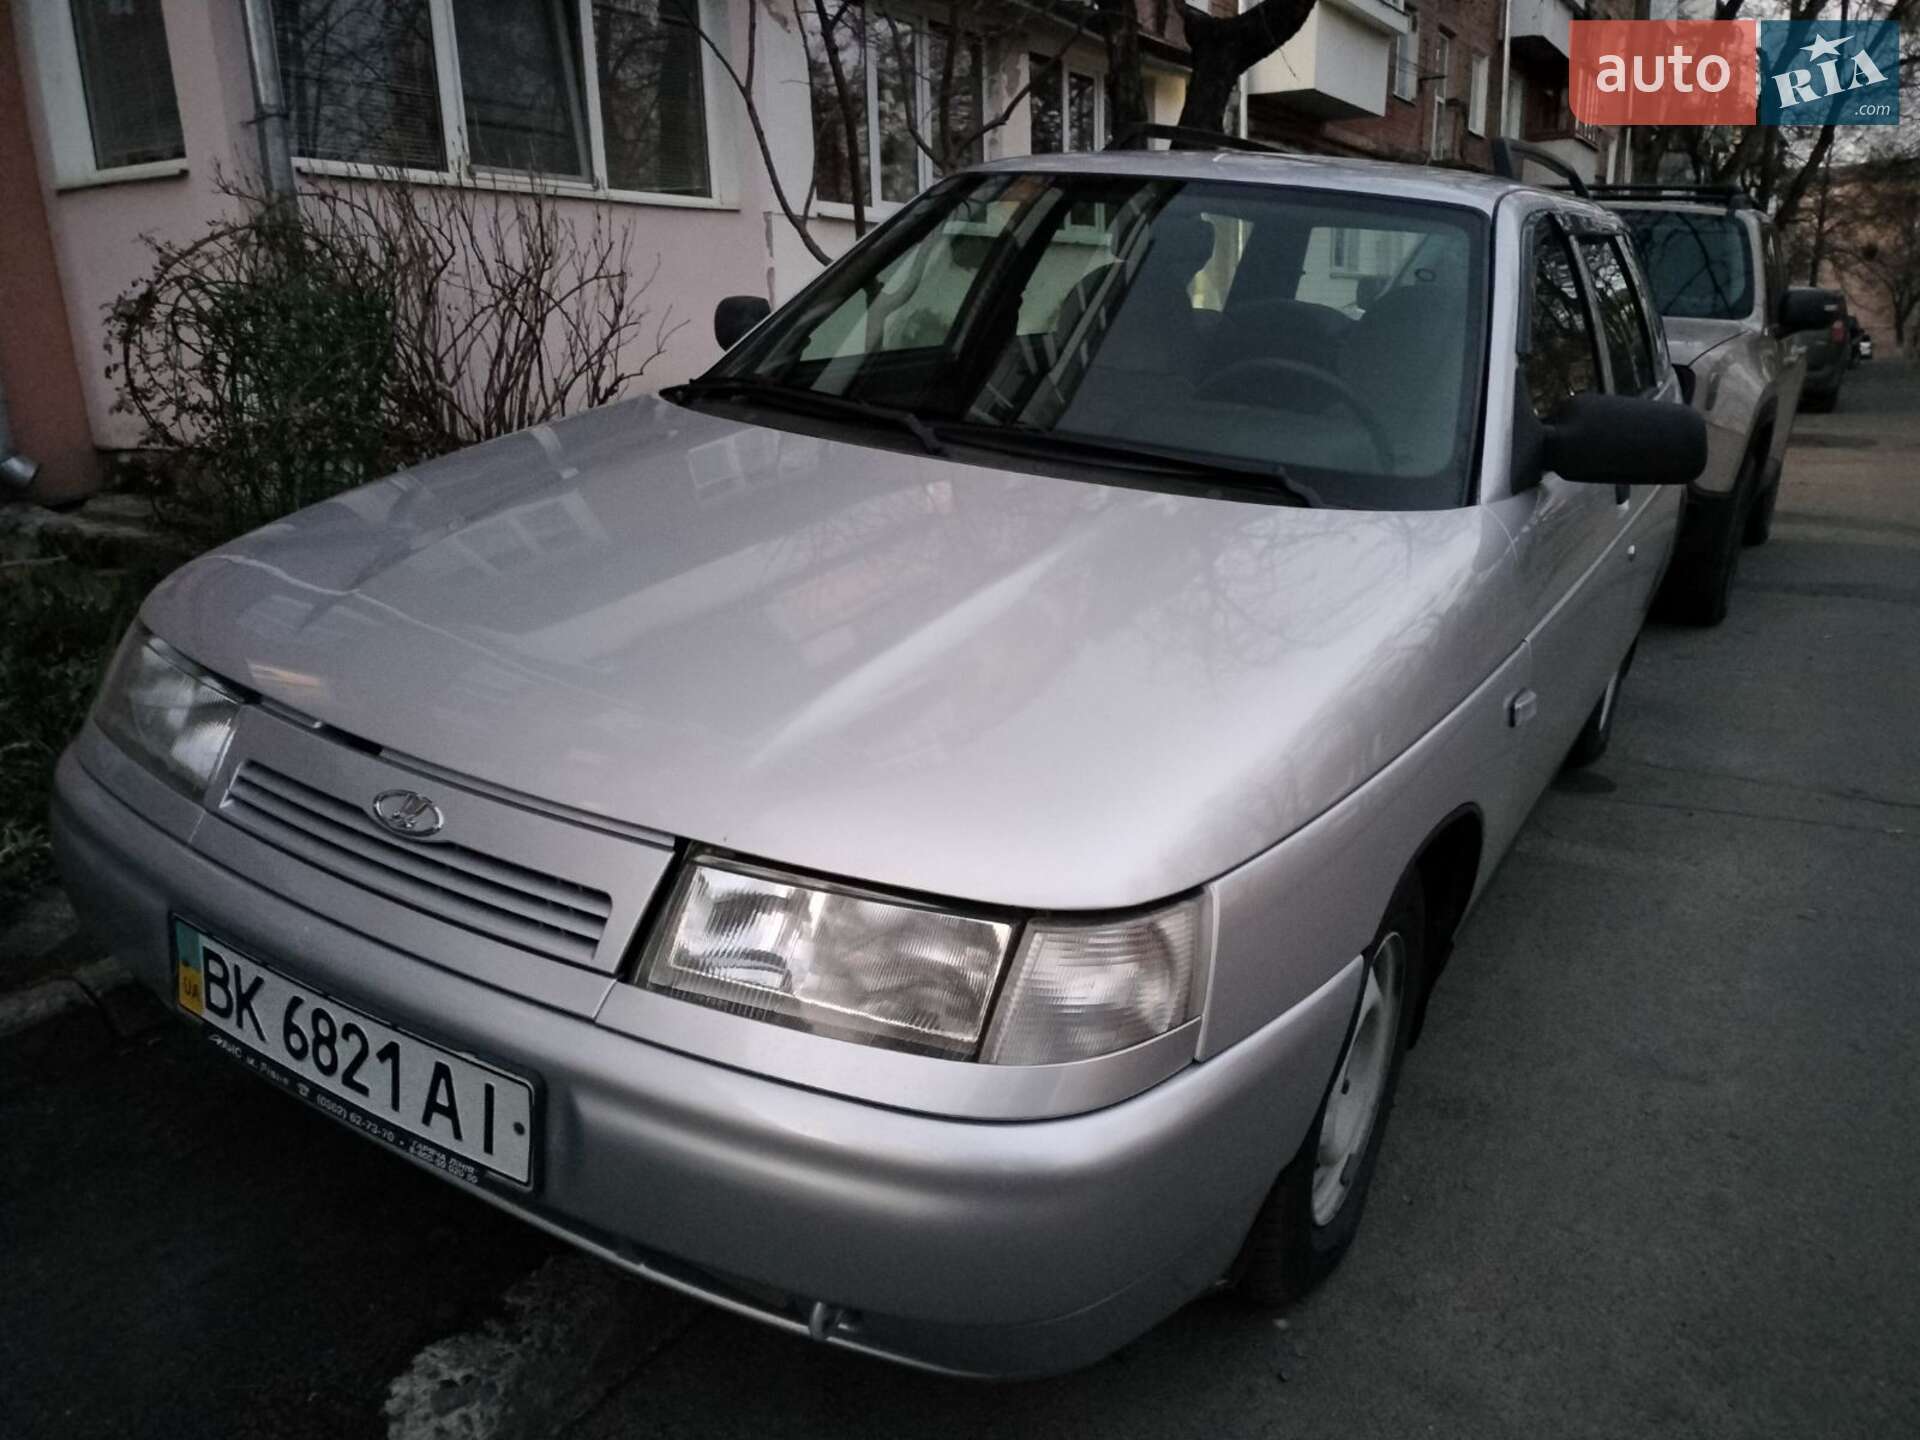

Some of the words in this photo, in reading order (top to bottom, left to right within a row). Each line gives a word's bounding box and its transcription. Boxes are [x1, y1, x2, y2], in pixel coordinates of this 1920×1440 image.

[203, 946, 267, 1042] BK
[283, 995, 401, 1112] 6821
[421, 1060, 495, 1156] AI
